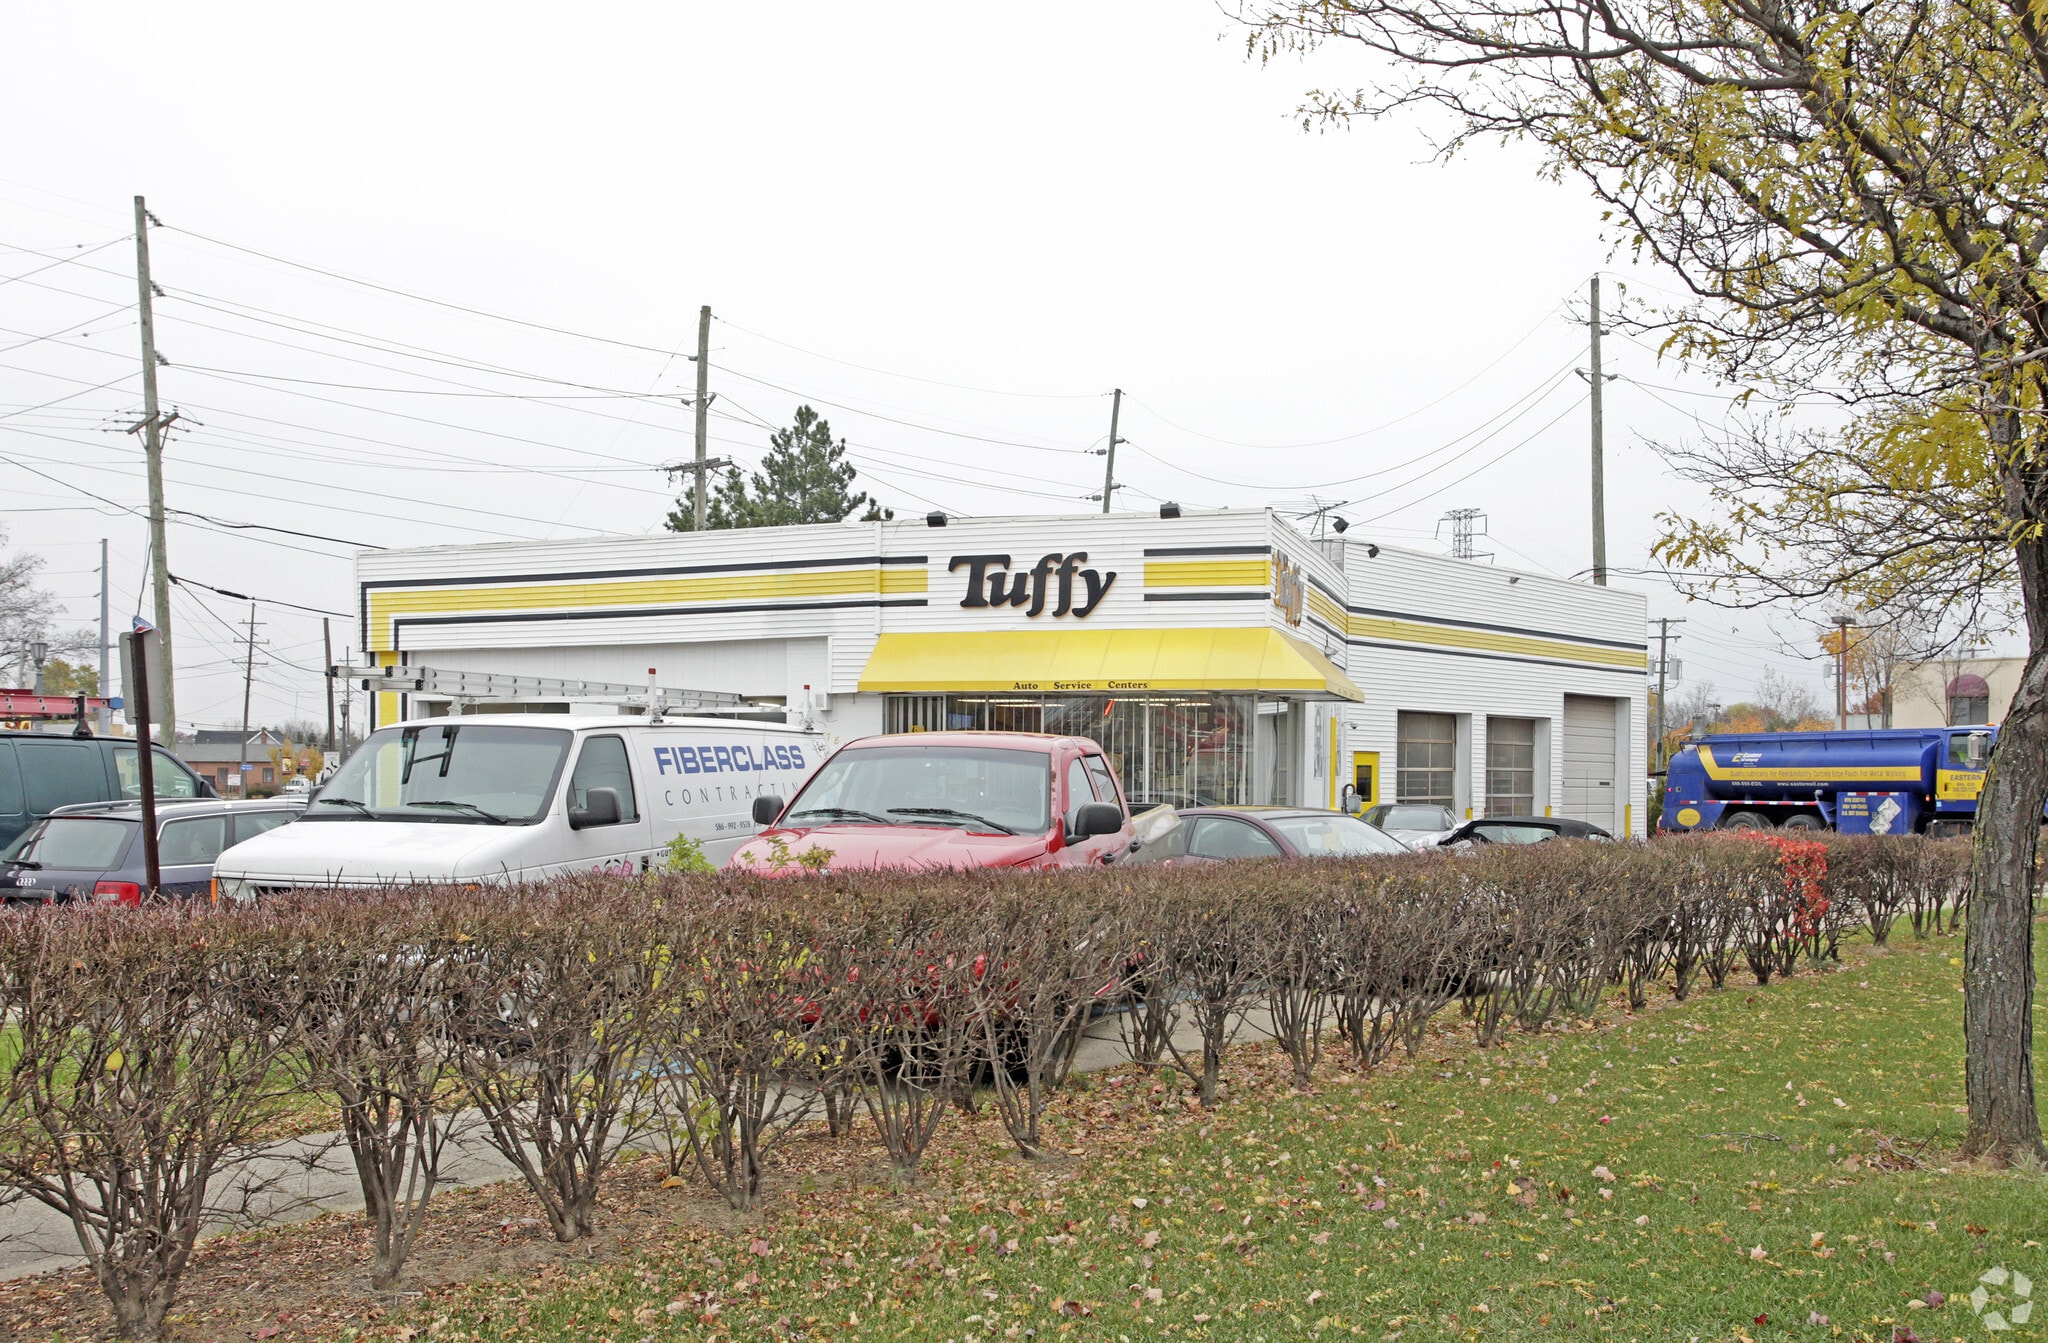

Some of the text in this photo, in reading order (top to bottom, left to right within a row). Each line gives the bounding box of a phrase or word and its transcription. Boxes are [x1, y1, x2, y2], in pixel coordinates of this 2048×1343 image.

[948, 551, 1117, 618] Tuffy
[1013, 680, 1148, 690] Auto Service Centers
[653, 745, 806, 776] FIBERCLASS
[664, 782, 801, 806] CONTRACTIN
